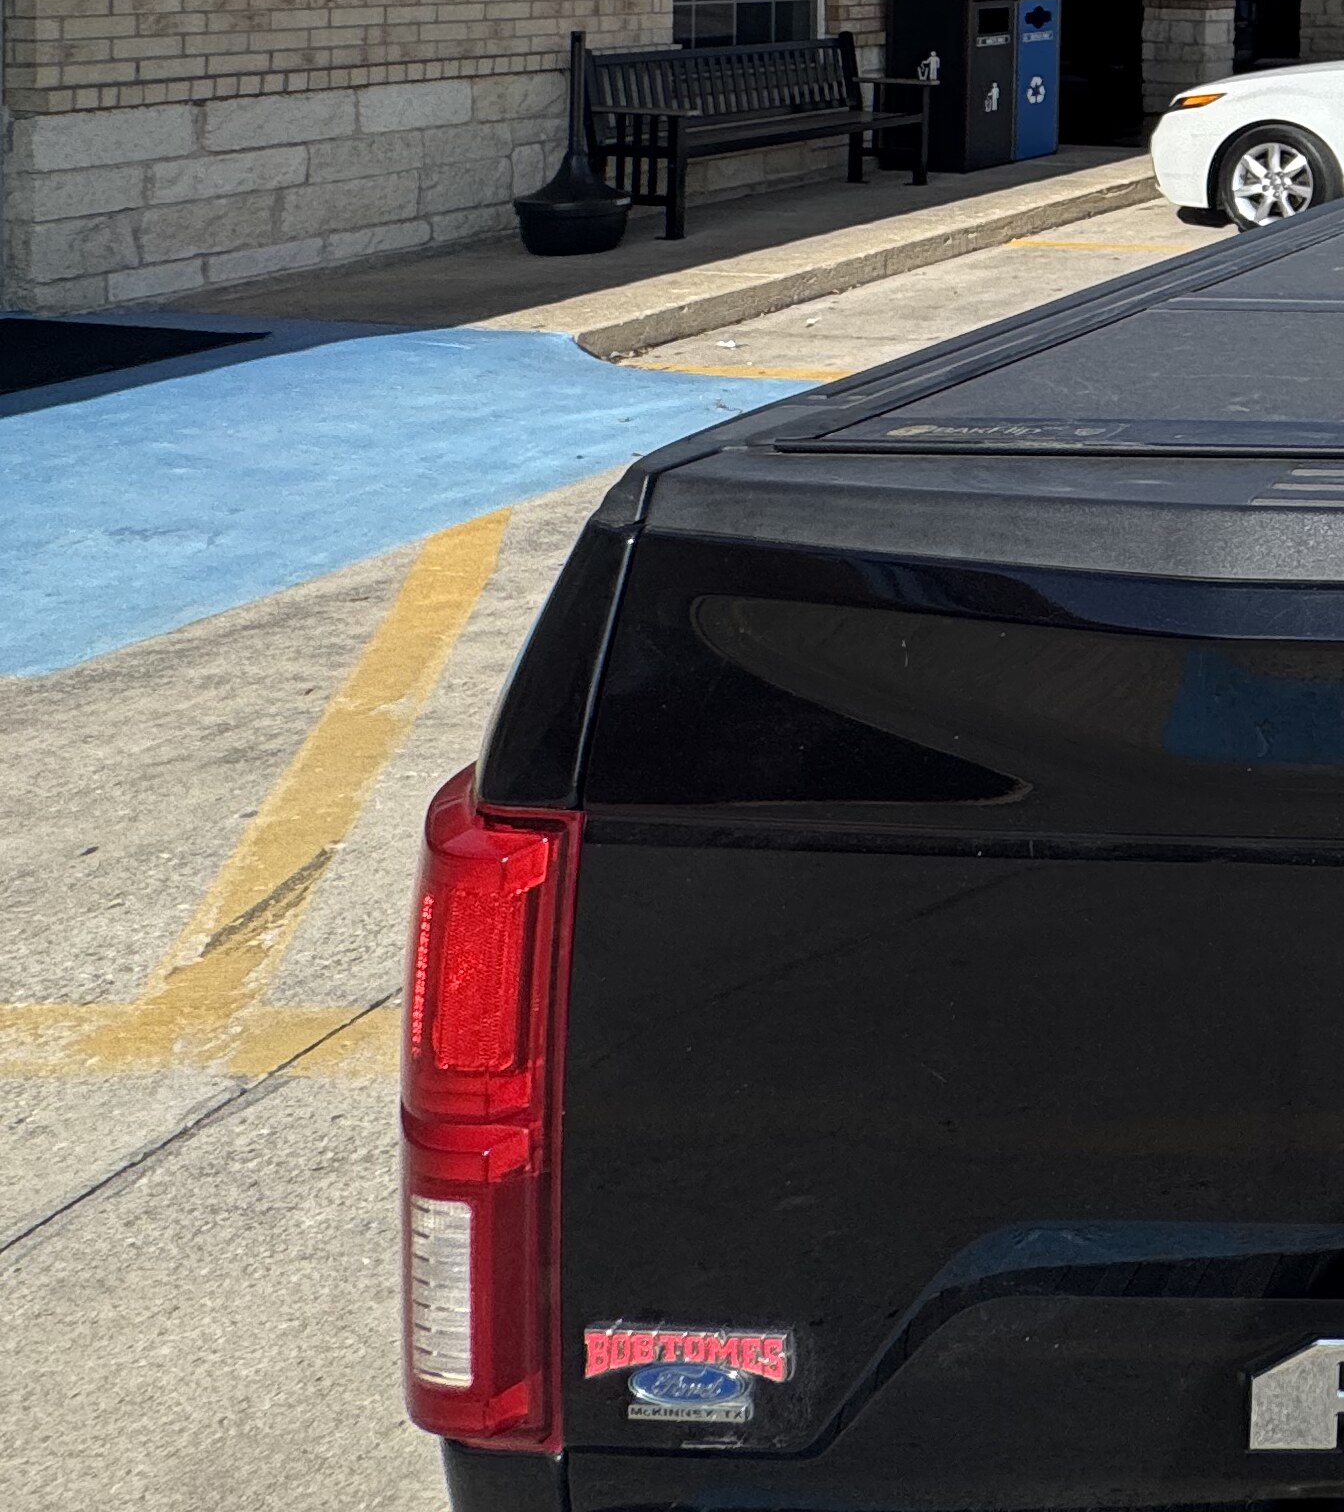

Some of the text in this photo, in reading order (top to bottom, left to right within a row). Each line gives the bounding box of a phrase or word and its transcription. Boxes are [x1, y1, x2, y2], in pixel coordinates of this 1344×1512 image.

[584, 1331, 787, 1382] BOB TOMES
[652, 1367, 725, 1397] Ford
[724, 1407, 744, 1420] TX
